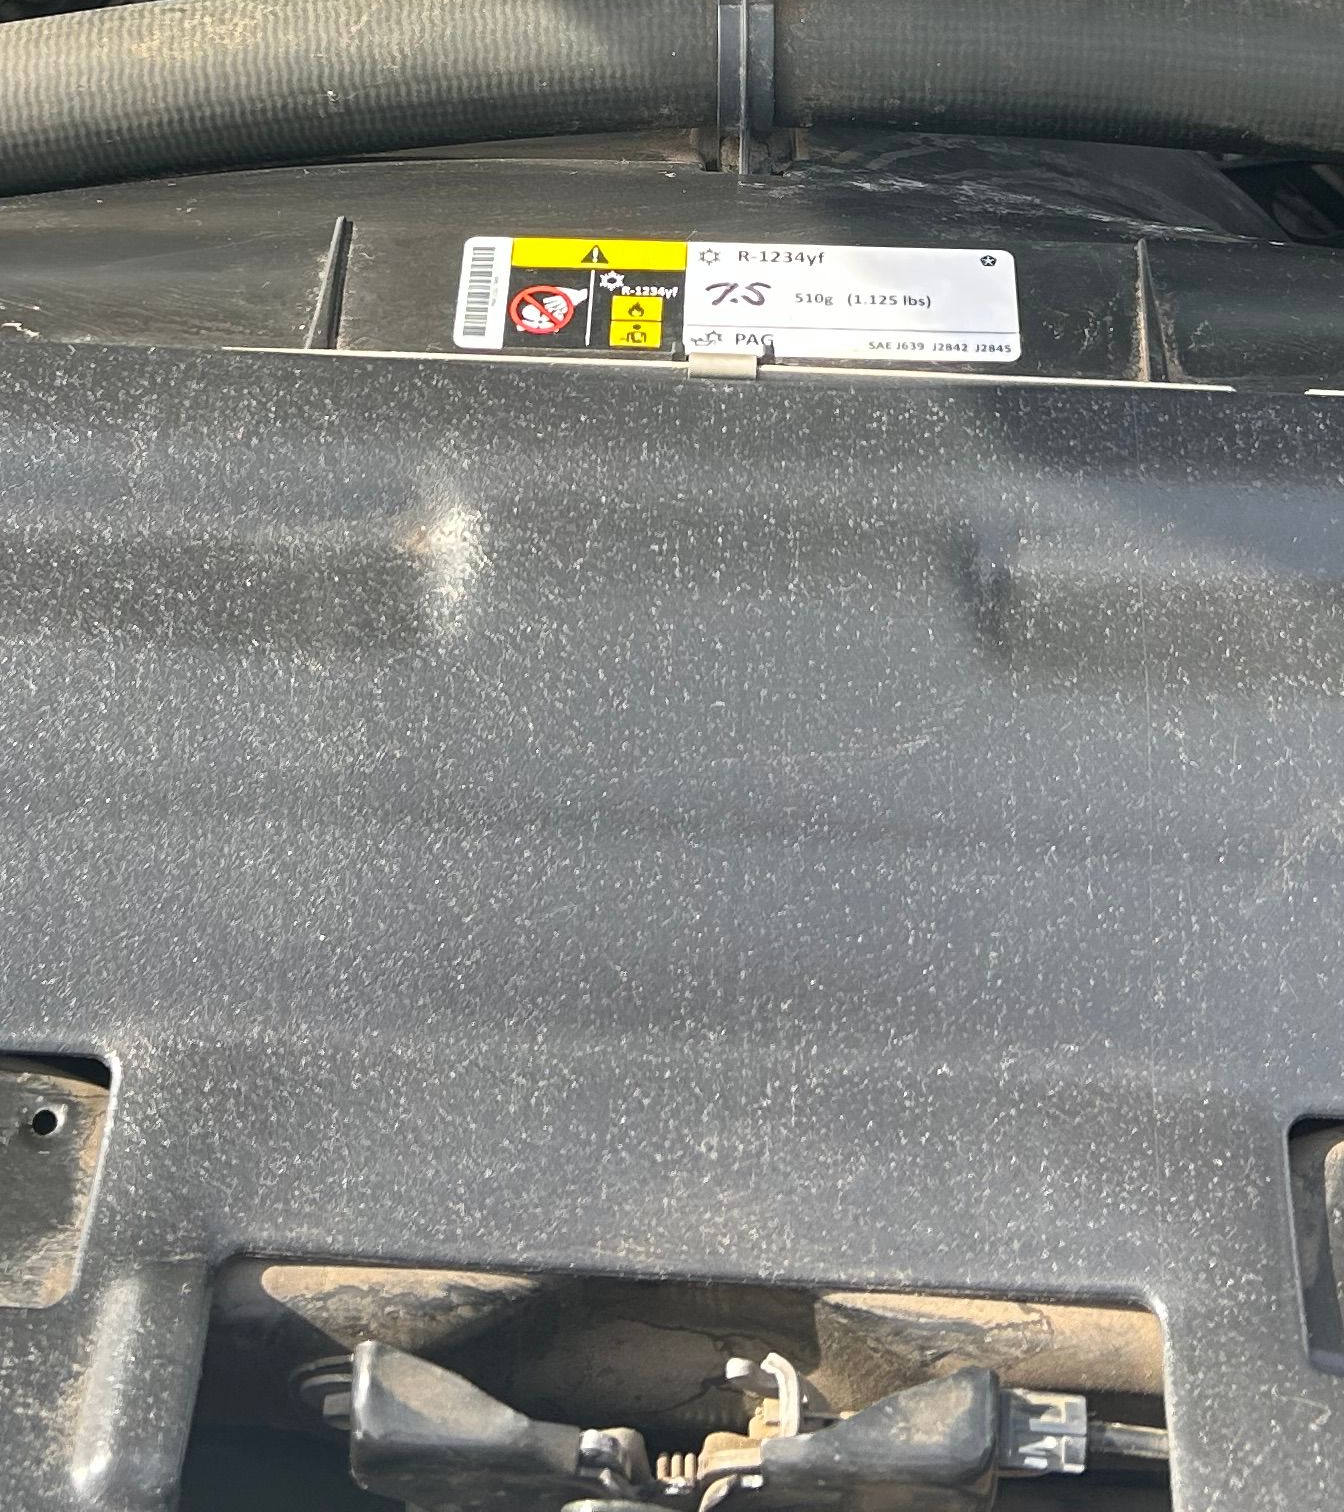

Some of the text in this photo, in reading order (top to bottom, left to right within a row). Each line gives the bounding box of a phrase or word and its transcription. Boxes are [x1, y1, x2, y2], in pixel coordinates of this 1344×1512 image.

[737, 250, 825, 267] R-1234yf
[620, 285, 679, 299] R-1234yf
[705, 281, 773, 307] 7.5
[794, 292, 932, 309] 510g (1.125 lbs)
[734, 333, 775, 346] PAG
[867, 340, 1012, 354] SAE J639 J2842 J2845
